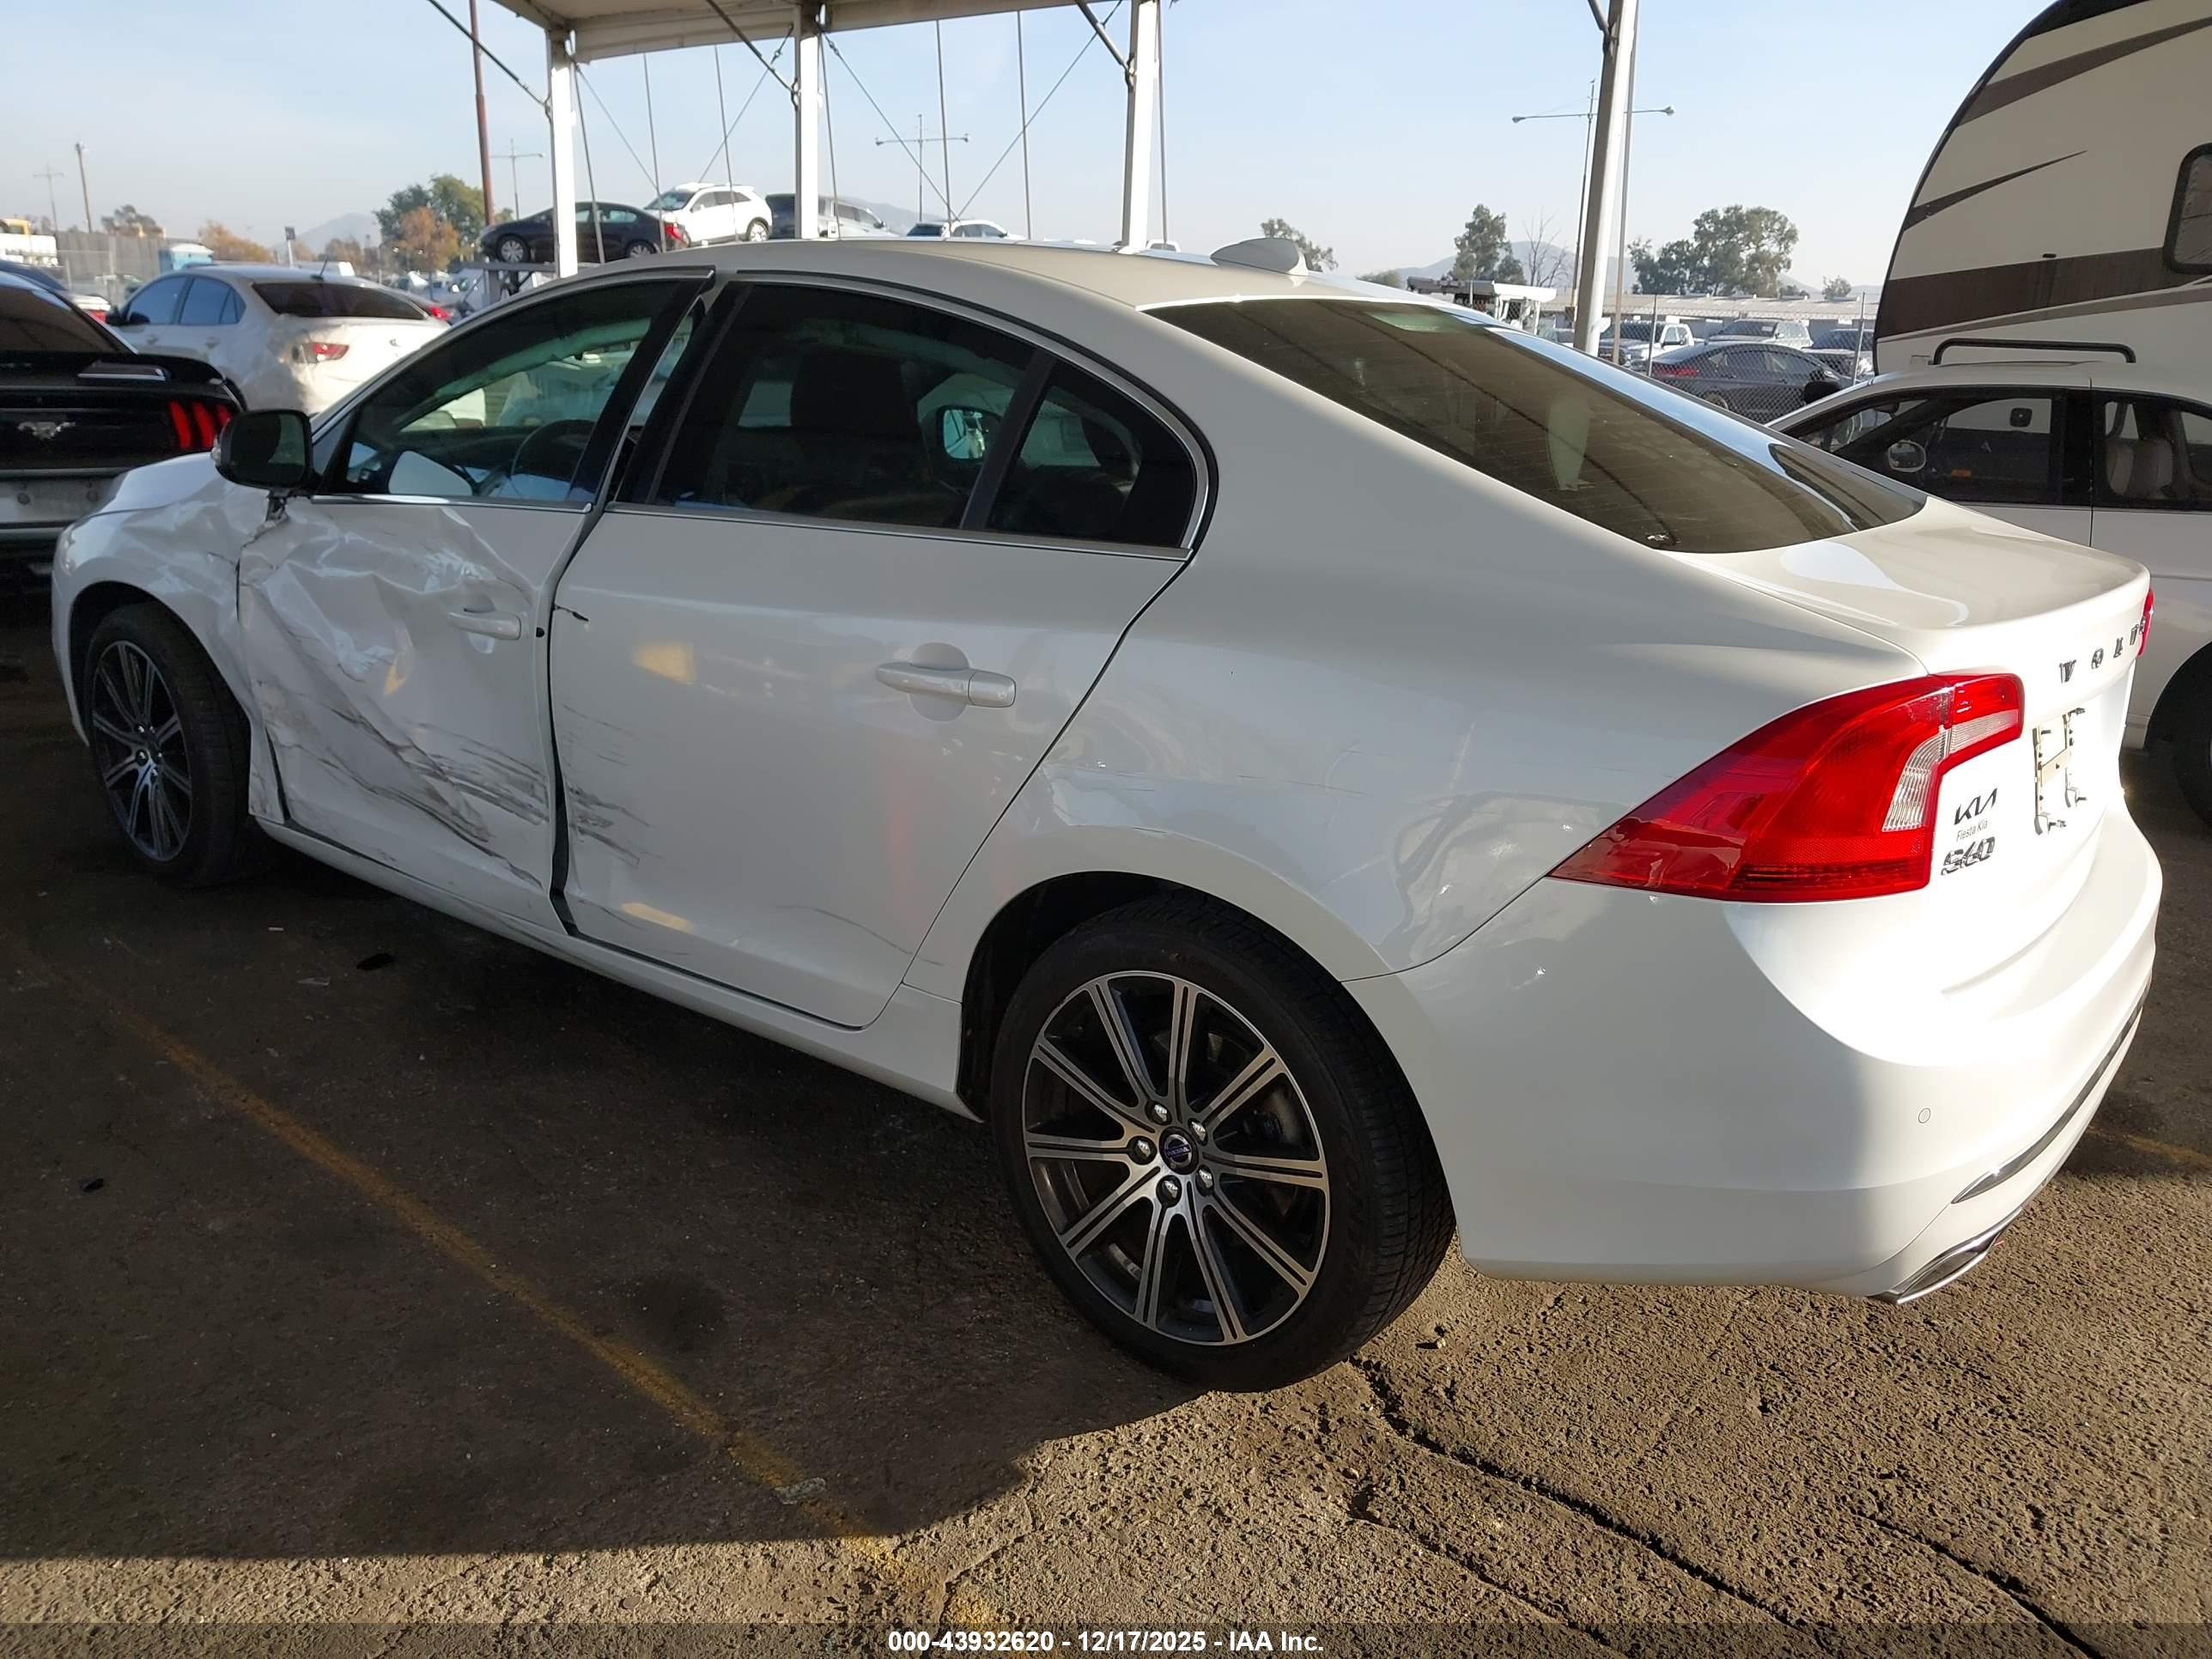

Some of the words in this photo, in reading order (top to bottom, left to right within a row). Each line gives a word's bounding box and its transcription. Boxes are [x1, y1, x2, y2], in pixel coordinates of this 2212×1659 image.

[1954, 787, 1997, 825] KIA
[1956, 825, 1976, 842] Fiesta
[1977, 818, 1989, 832] Kia
[1941, 836, 1996, 876] S60
